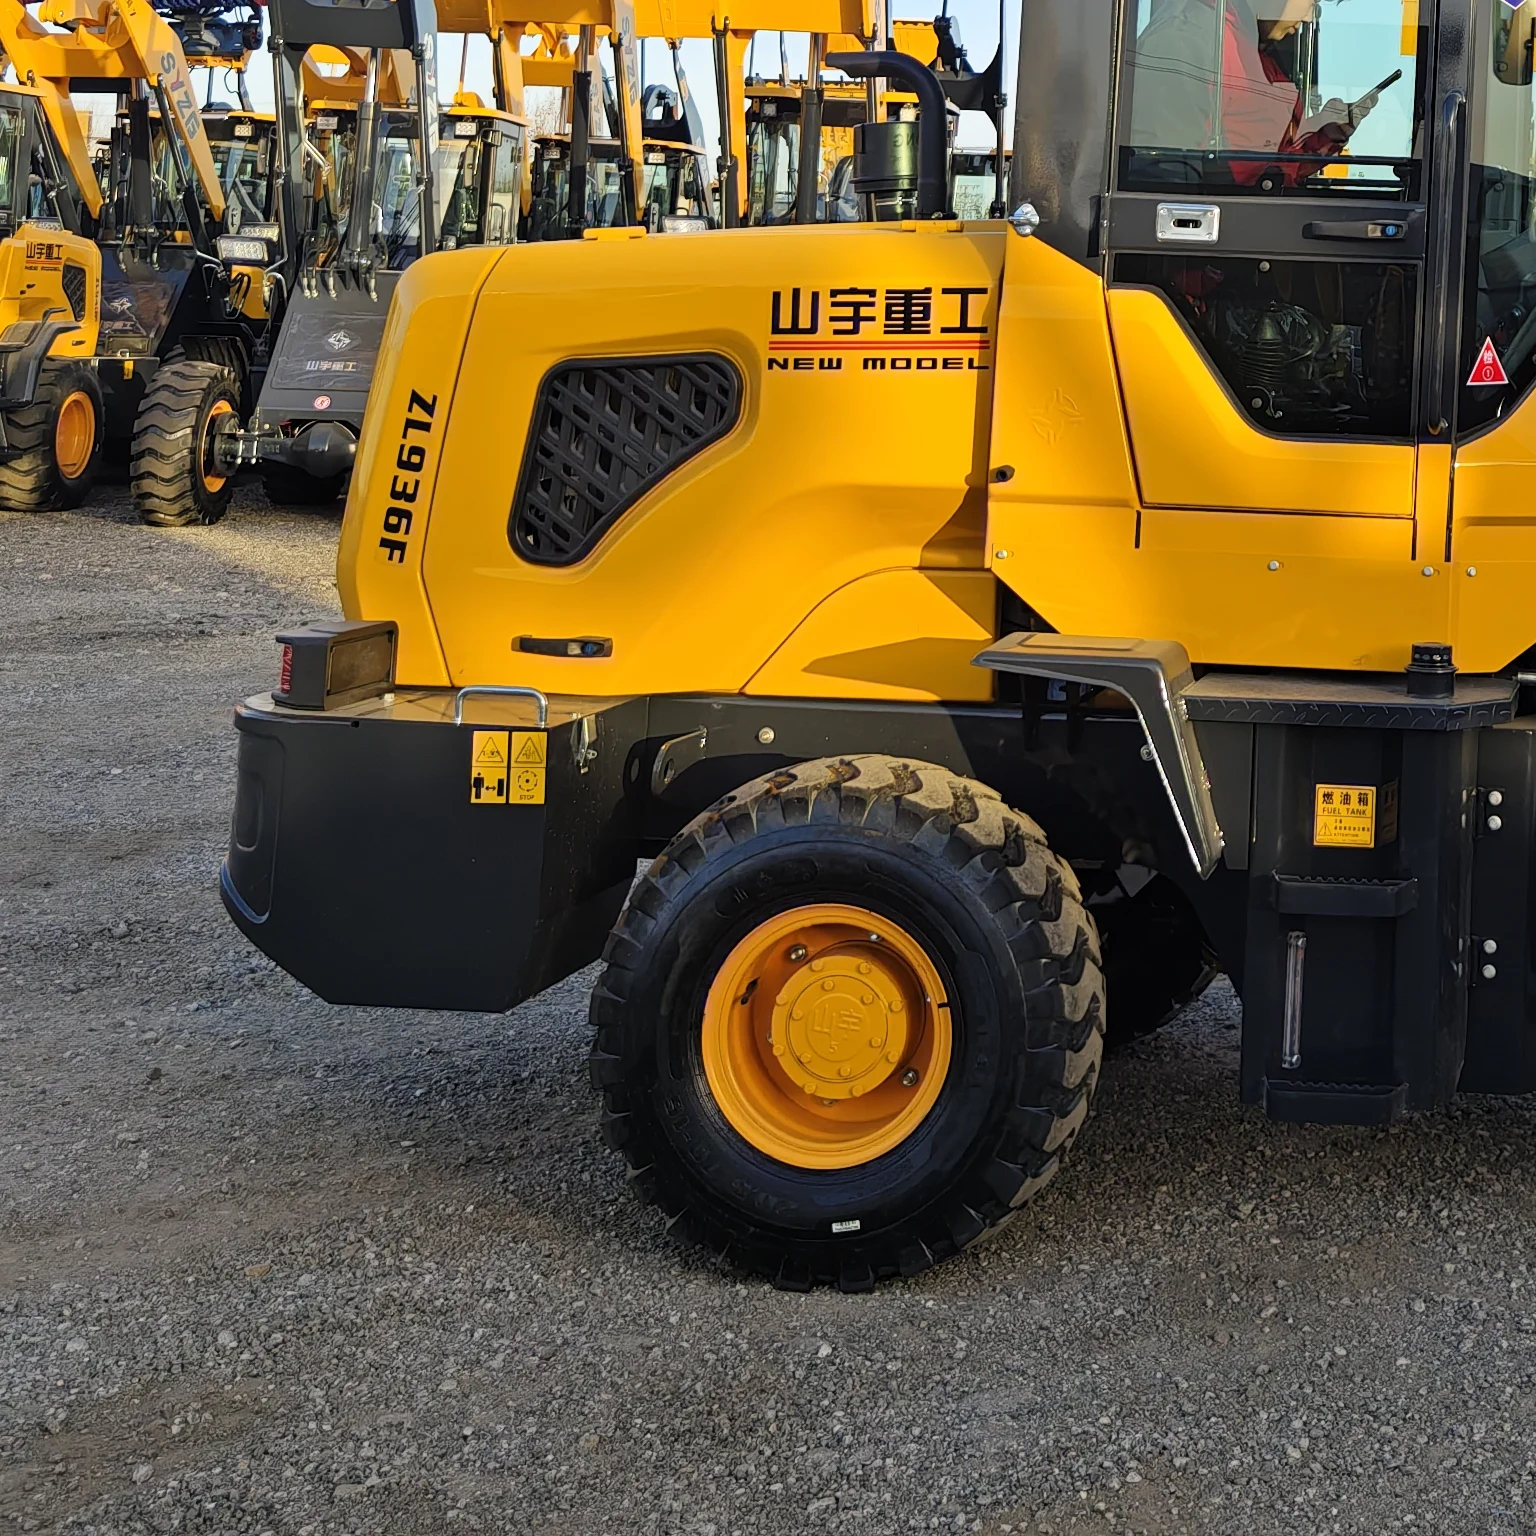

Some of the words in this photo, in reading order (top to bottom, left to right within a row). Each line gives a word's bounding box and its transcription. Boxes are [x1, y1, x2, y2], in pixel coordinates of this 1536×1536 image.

[161, 51, 200, 140] SYZG
[26, 241, 63, 260] 山宇重工
[771, 287, 989, 336] 山宇重工
[768, 357, 843, 370] NEW
[862, 357, 990, 370] MODEL
[379, 388, 438, 564] ZL936F
[1322, 791, 1369, 806] 燃油箱
[1346, 808, 1367, 816] TANK
